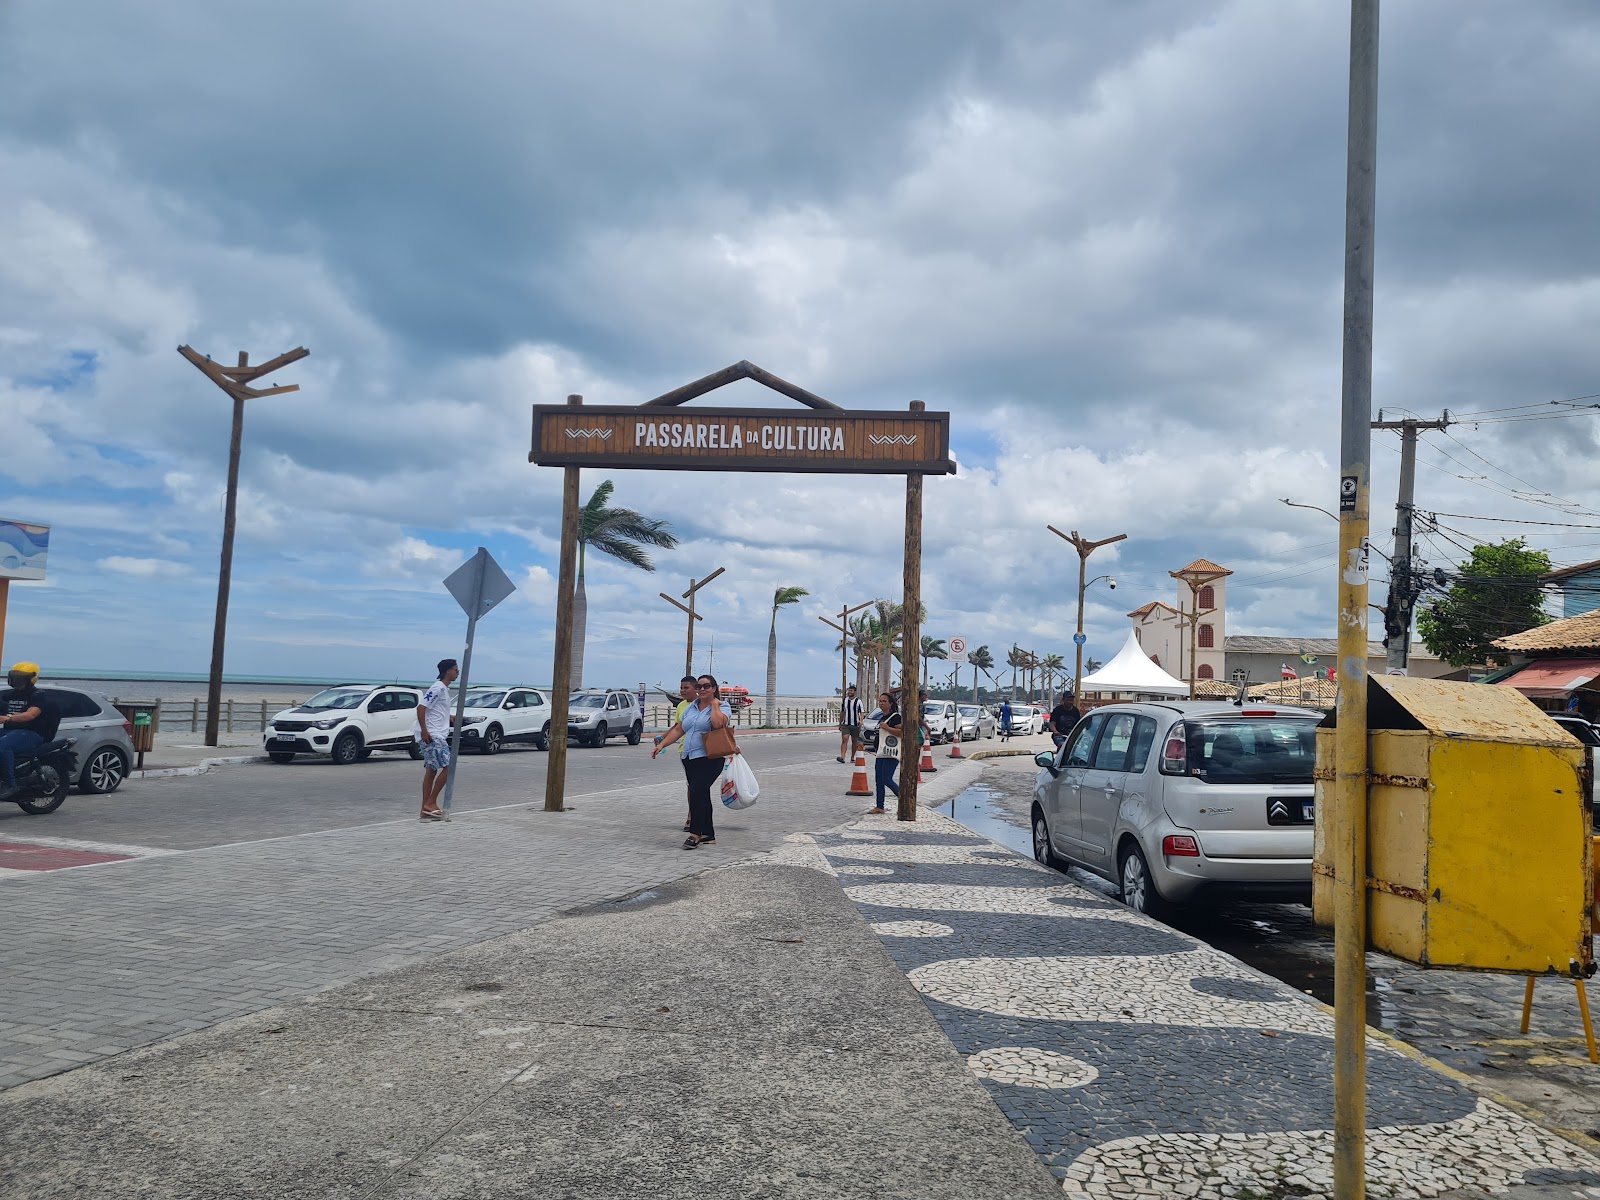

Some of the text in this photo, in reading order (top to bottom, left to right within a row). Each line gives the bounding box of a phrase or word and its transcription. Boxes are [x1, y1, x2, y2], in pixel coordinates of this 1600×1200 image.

[635, 422, 845, 451] PASSARELA DA CULTURA
